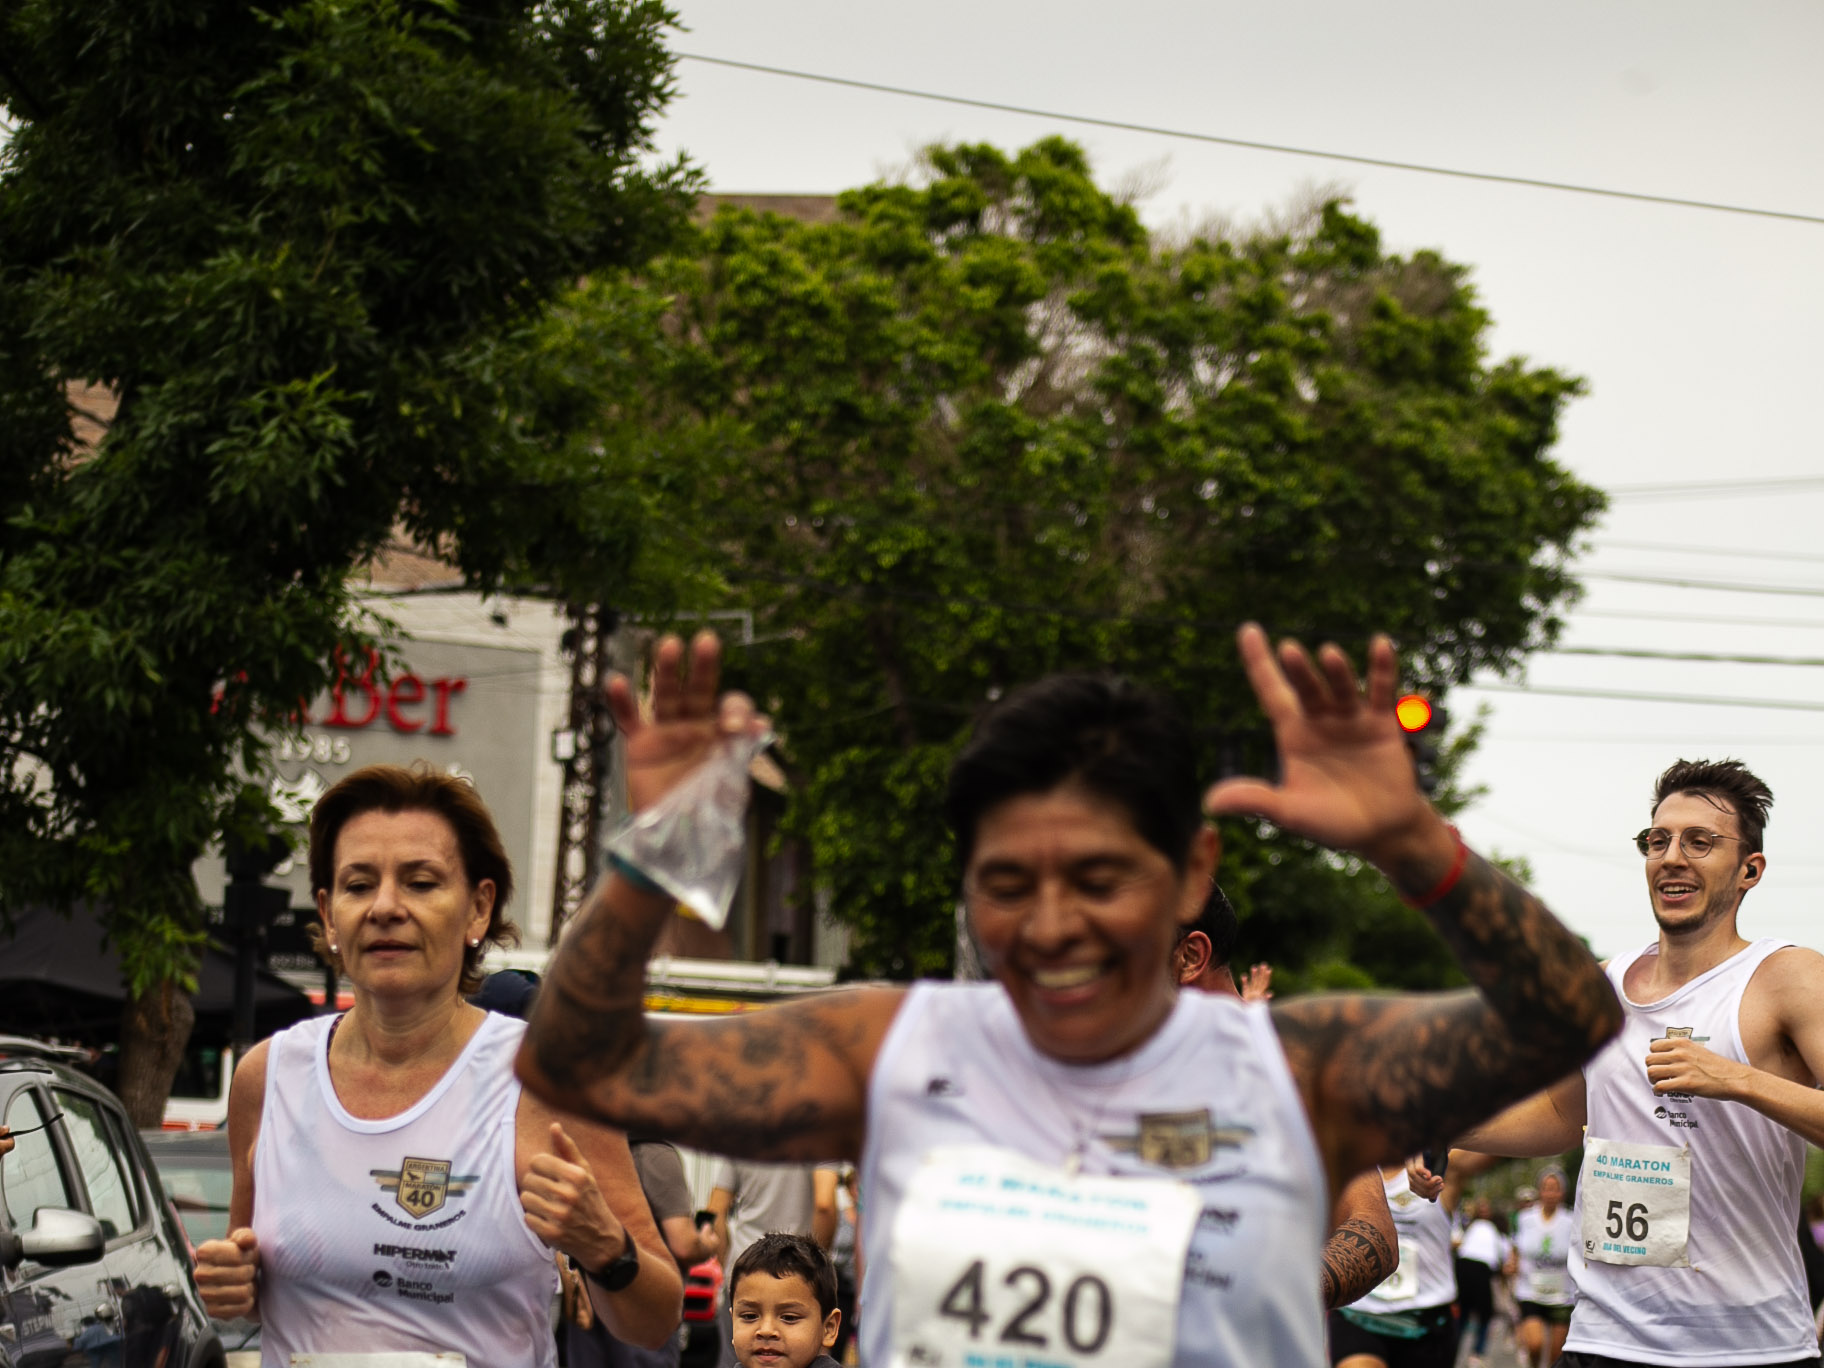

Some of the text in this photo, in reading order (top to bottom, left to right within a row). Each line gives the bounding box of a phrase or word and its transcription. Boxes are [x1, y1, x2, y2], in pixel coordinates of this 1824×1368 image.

[1596, 1155, 1671, 1172] 40 MARATON
[1593, 1170, 1674, 1186] EMPALME GRANEROS
[407, 1190, 435, 1208] 40
[1605, 1200, 1649, 1242] 56
[1623, 1245, 1647, 1256] VECINO
[397, 1278, 433, 1291] Banco
[398, 1289, 454, 1304] Municipal
[938, 1258, 1114, 1357] 420
